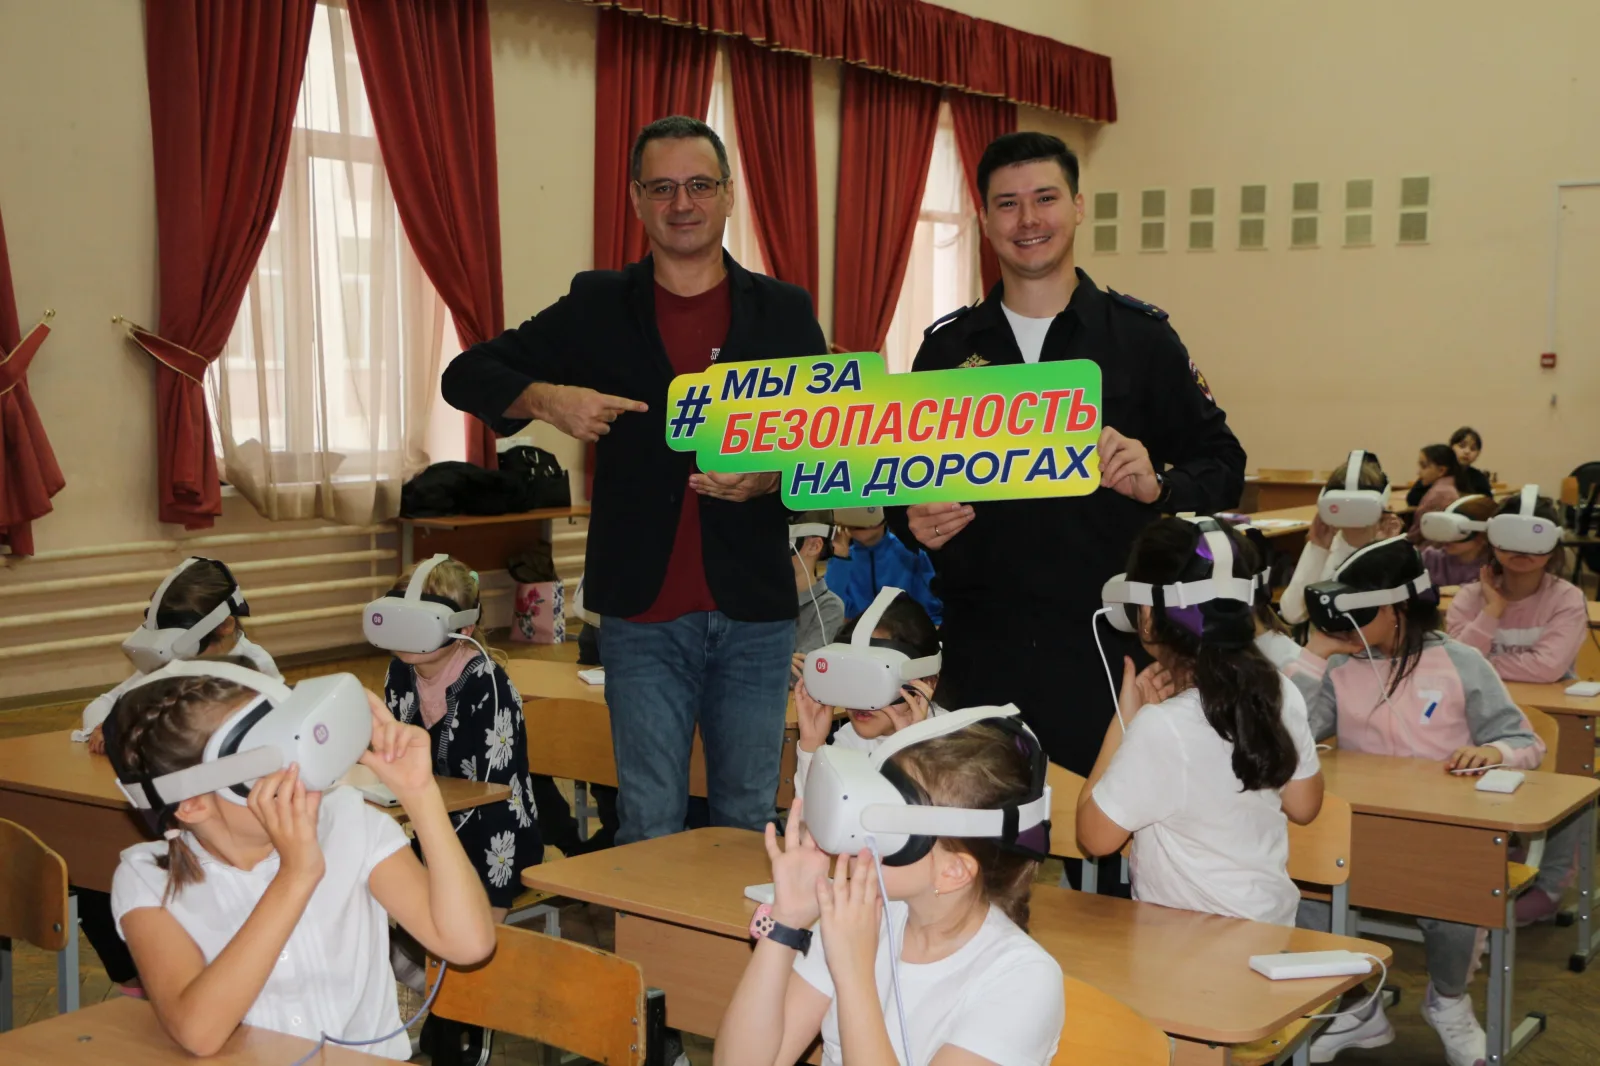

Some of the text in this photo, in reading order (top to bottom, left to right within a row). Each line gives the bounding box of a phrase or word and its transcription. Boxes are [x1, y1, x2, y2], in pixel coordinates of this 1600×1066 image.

[669, 360, 862, 438] # МЫ ЗА
[719, 388, 1098, 454] БЕЗОПАСНОСТЬ
[789, 445, 1097, 497] НА ДОРОГАХ
[1417, 689, 1443, 725] 7
